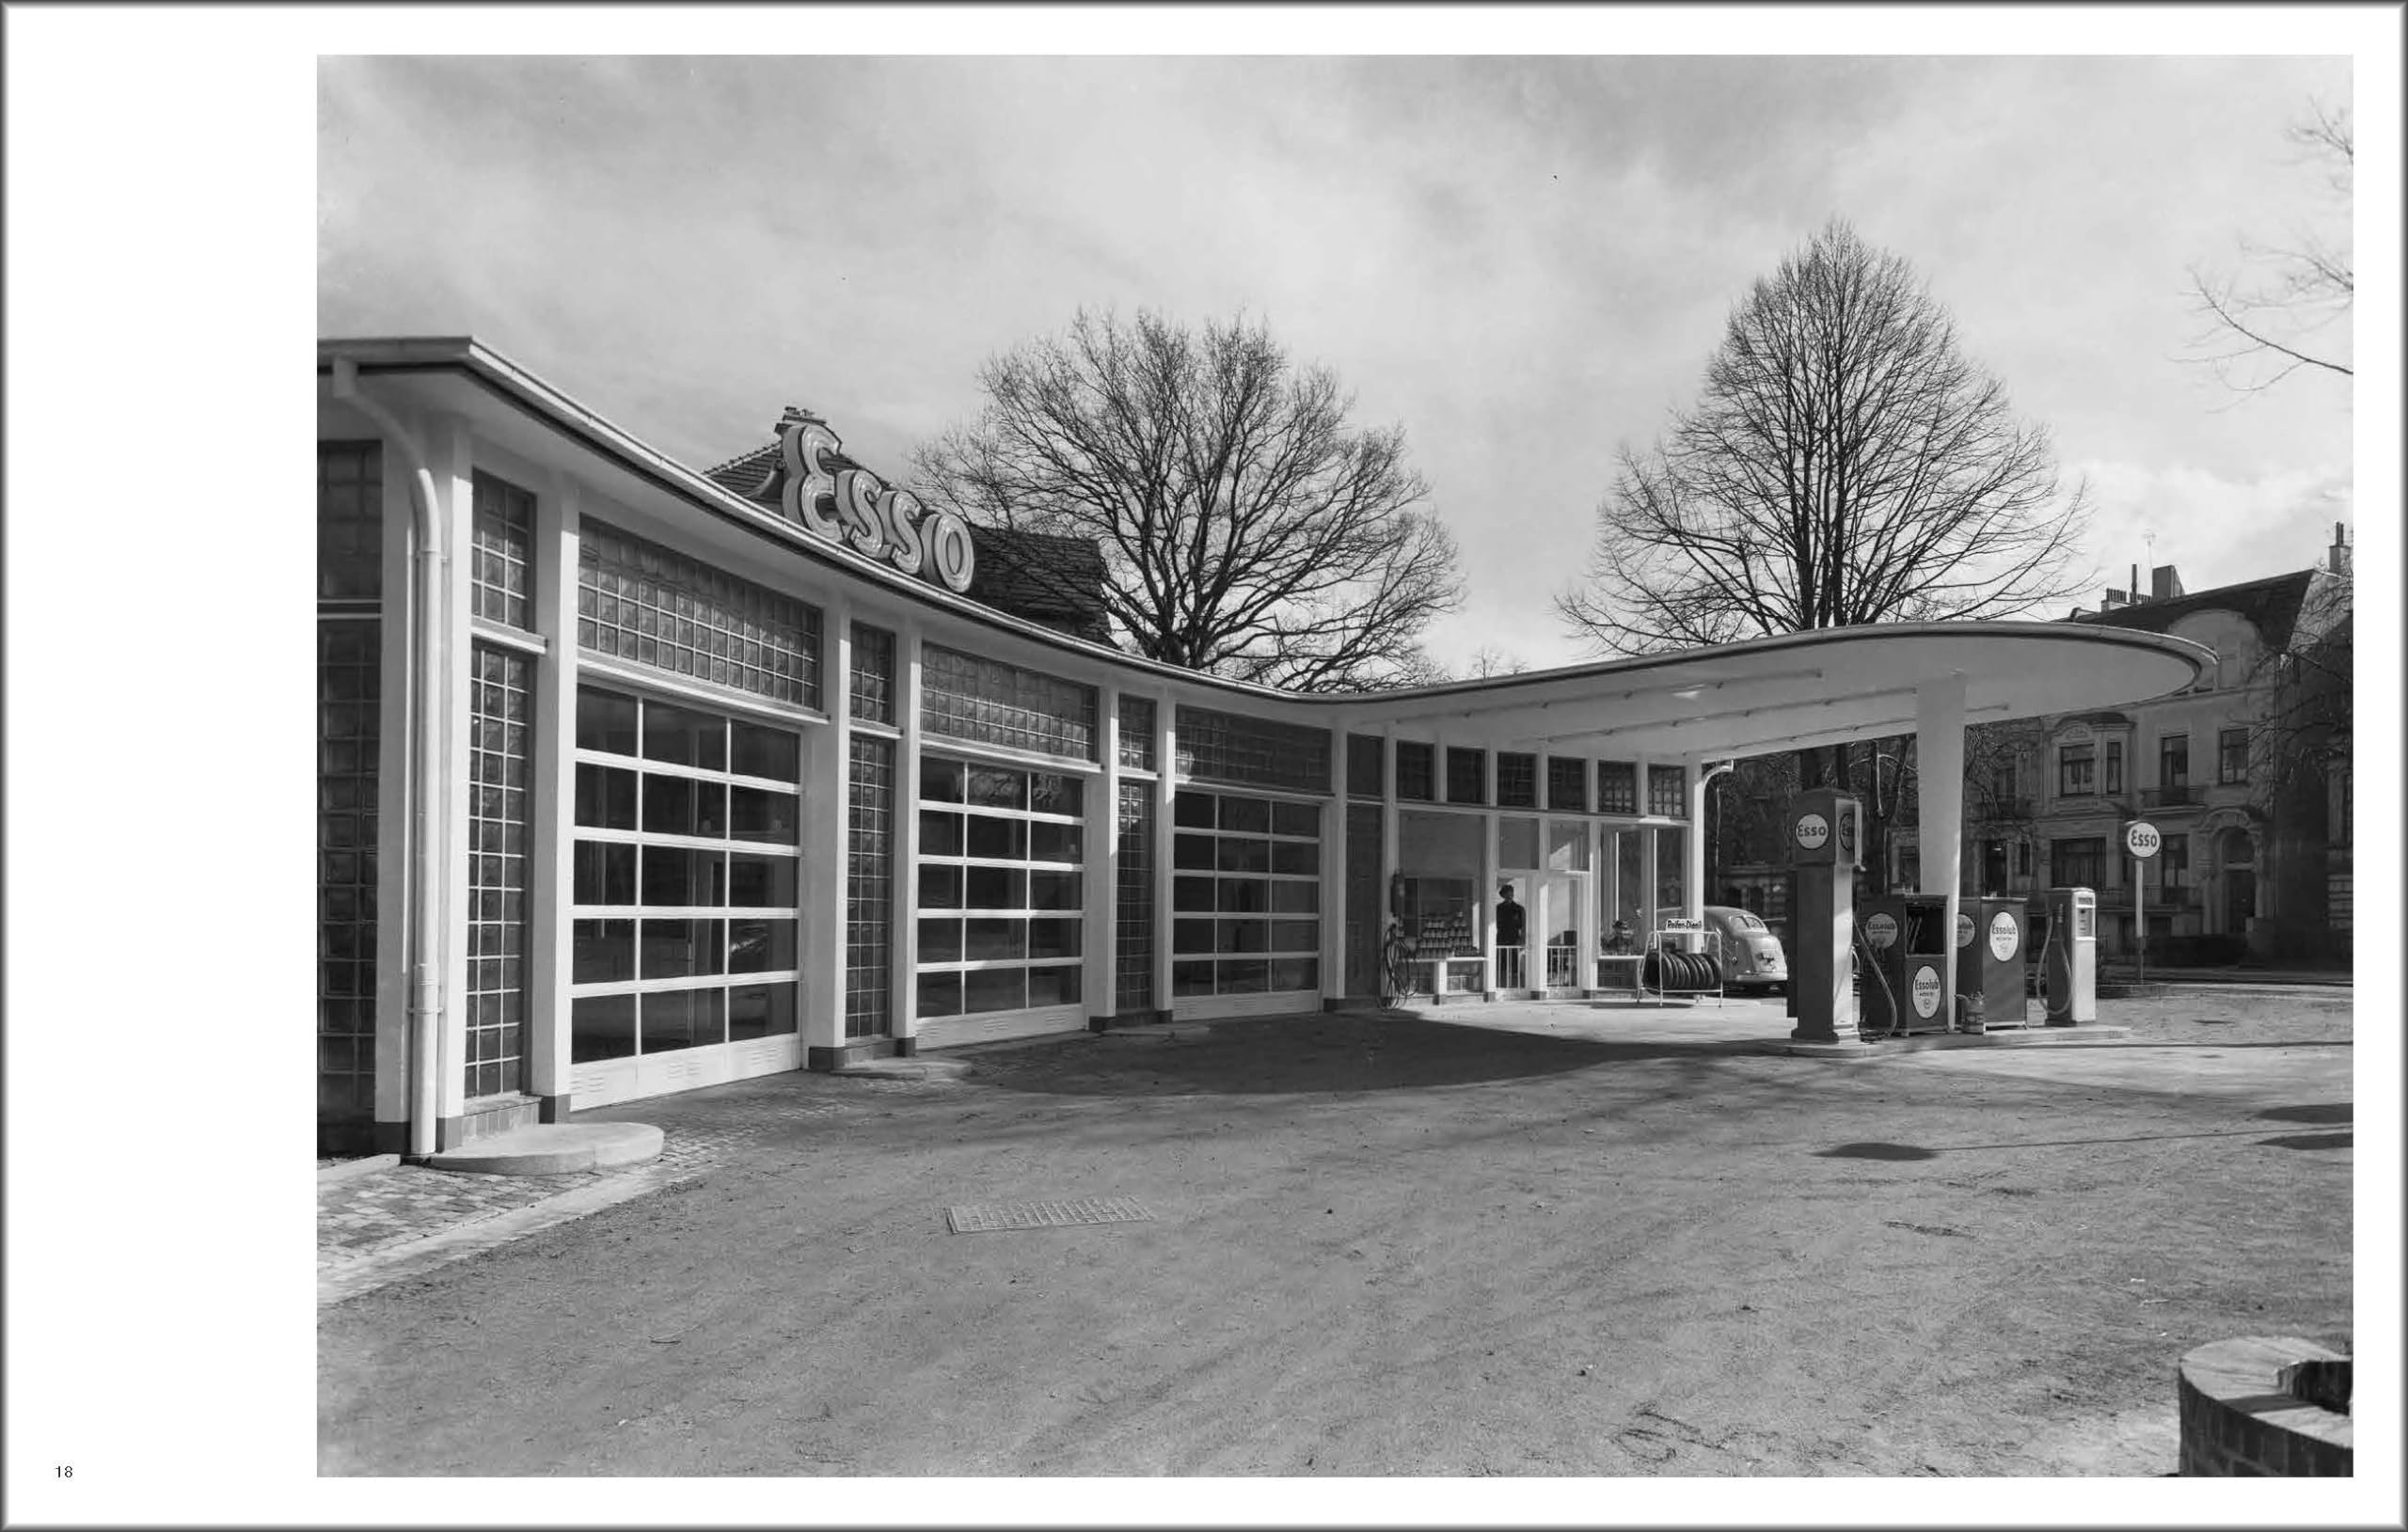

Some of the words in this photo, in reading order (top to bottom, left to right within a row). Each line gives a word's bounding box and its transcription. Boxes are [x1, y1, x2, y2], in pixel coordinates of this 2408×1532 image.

[783, 423, 974, 593] Esso
[1798, 824, 1827, 837] Esso
[2131, 829, 2158, 847] Esso
[1991, 924, 2017, 935] Essolub
[1915, 978, 1939, 990] Essolub
